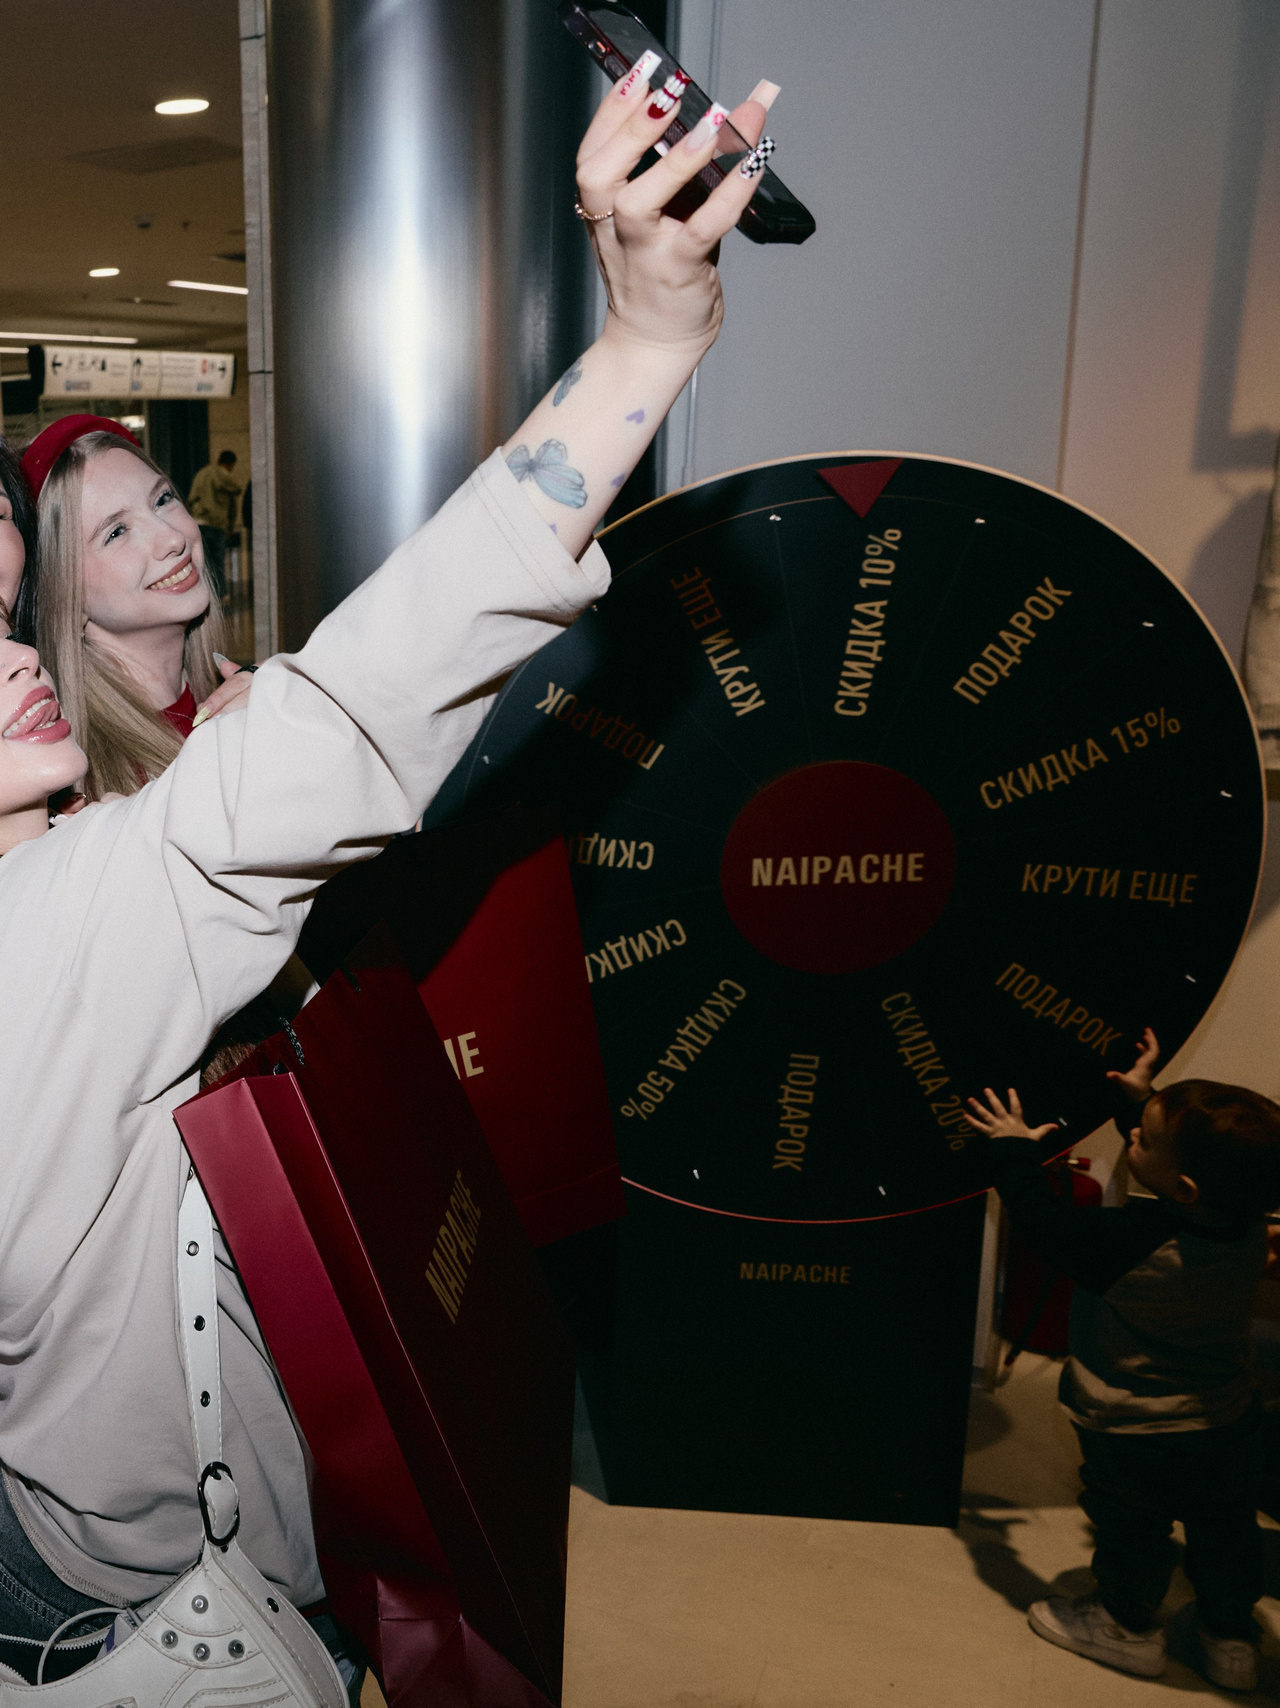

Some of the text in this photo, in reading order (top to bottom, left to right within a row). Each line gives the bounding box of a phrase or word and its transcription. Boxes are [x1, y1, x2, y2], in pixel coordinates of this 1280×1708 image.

[669, 564, 767, 718] КРУТИ ЕЩЕ
[833, 528, 903, 717] СКИДКА 10%
[952, 575, 1073, 705] ПОДАРОК
[534, 681, 666, 771] ПОДАРОК
[979, 706, 1182, 810] СКИДКА 15%
[569, 832, 655, 871] СКИД
[750, 851, 926, 888] NAIPACHE
[1021, 862, 1199, 909] КРУТИ ЕЩЕ
[619, 978, 748, 1121] СКИДКА 50%
[995, 961, 1124, 1057] ПОДАРОК
[771, 1052, 821, 1173] ПОДАРОК
[880, 991, 979, 1151] СКИДКА 20%
[424, 1169, 482, 1325] NAIPACHE
[739, 1261, 852, 1285] NAIPACHE
